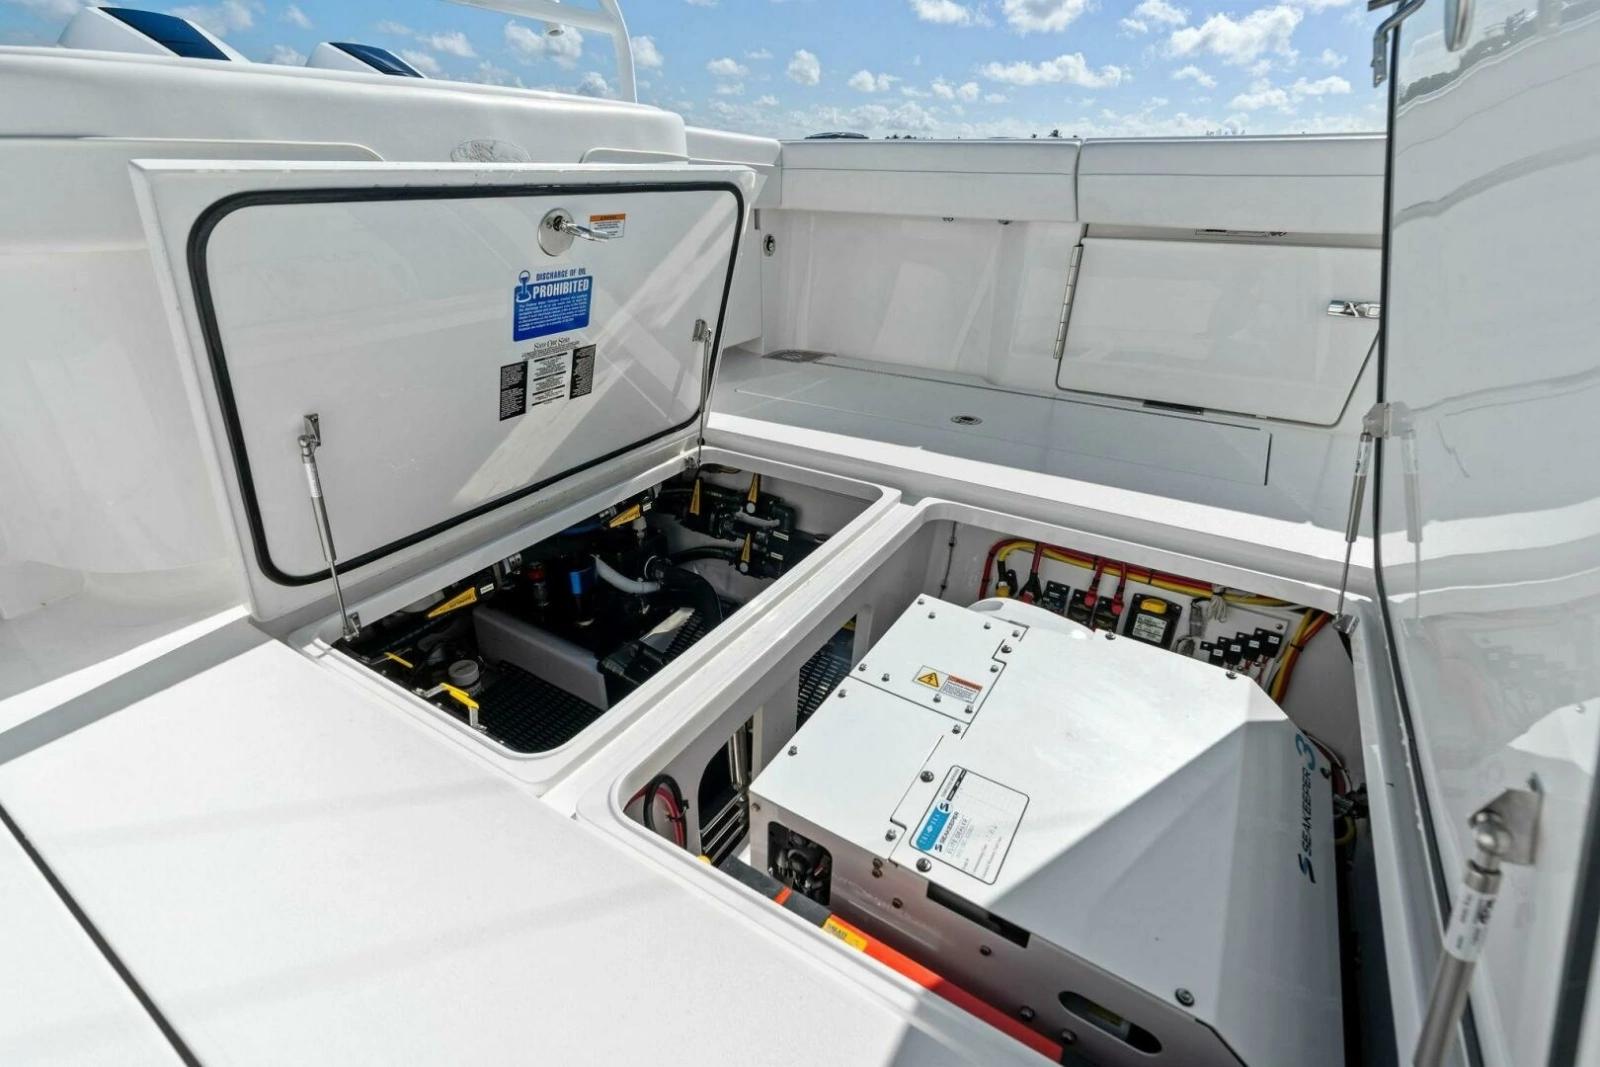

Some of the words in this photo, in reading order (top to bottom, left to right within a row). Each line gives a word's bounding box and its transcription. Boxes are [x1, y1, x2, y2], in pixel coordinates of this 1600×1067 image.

[532, 279, 589, 299] PROHIBITED
[536, 270, 567, 281] DISCHARGE
[569, 269, 577, 277] OF
[1295, 733, 1316, 771] 3
[939, 811, 959, 844] SEAKEEPER
[1301, 767, 1312, 857] SEAKEEPER
